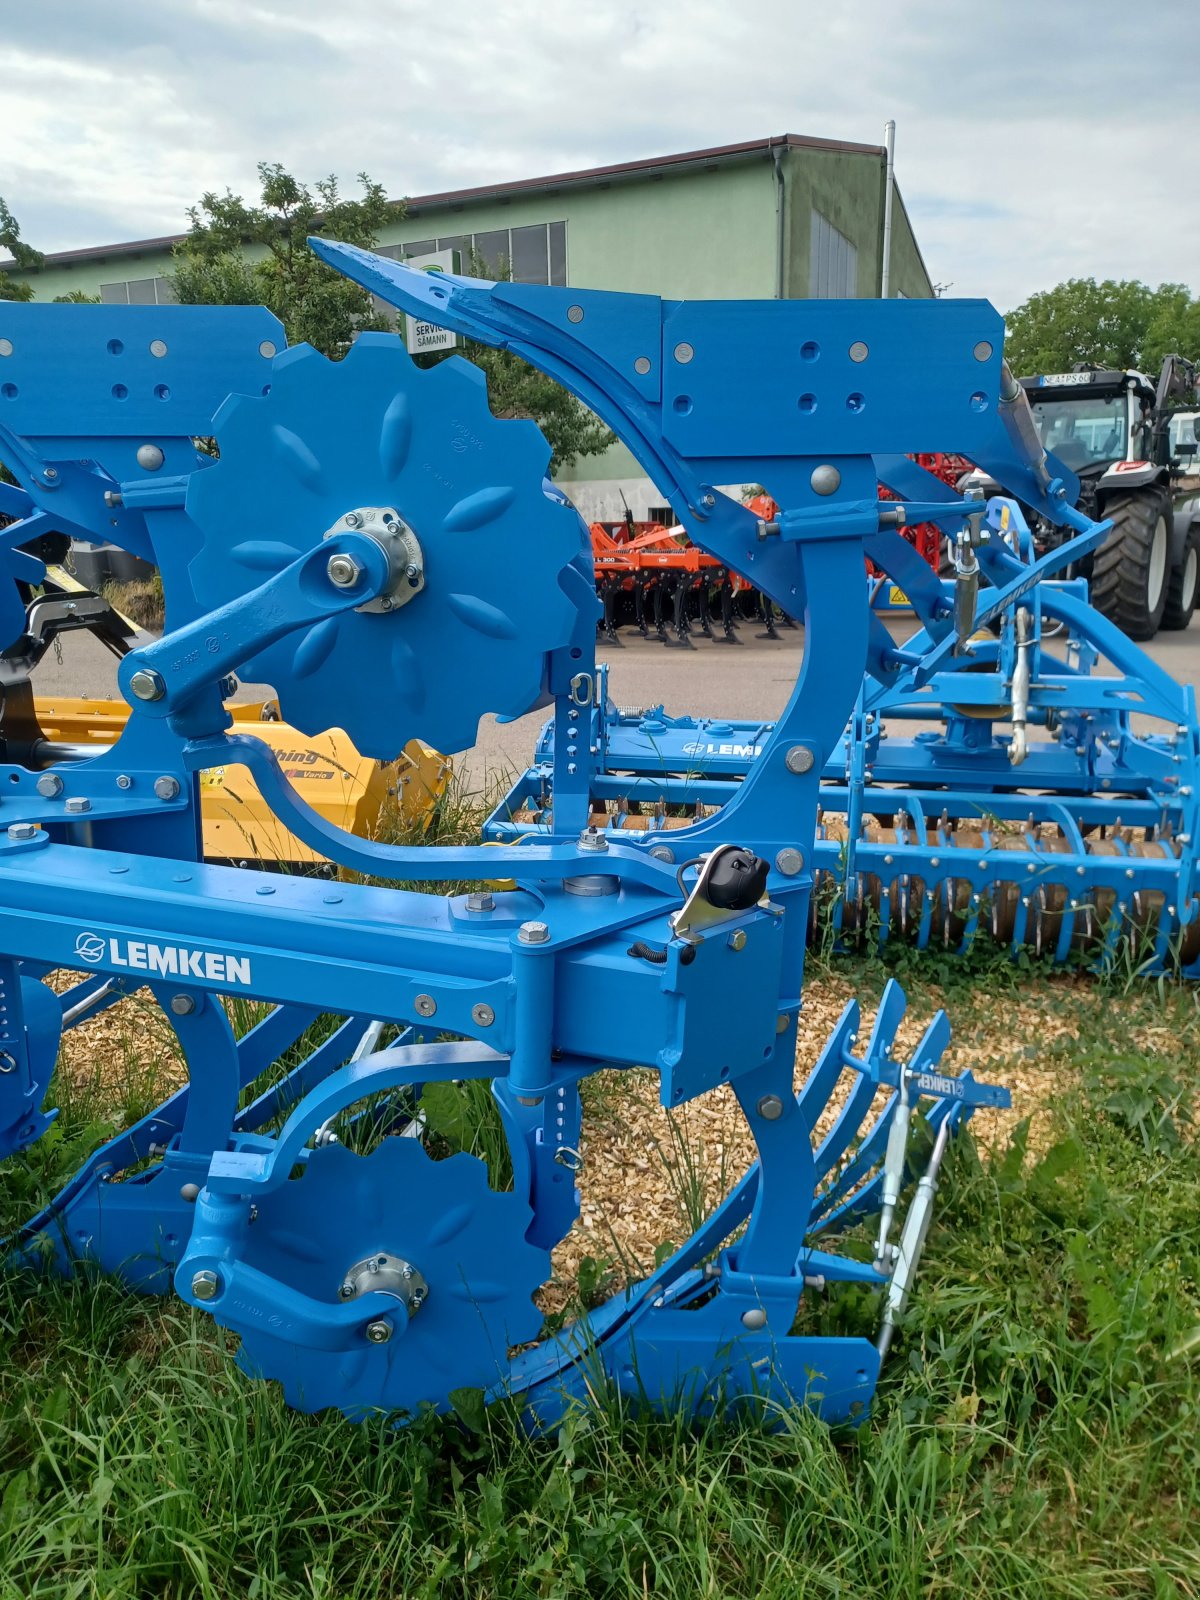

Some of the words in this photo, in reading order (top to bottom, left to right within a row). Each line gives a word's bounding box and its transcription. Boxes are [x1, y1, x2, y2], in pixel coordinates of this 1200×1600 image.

[416, 324, 443, 336] SERVIC
[417, 333, 447, 347] SÄMANN
[303, 771, 327, 779] Vario
[109, 938, 251, 985] LEMKEN
